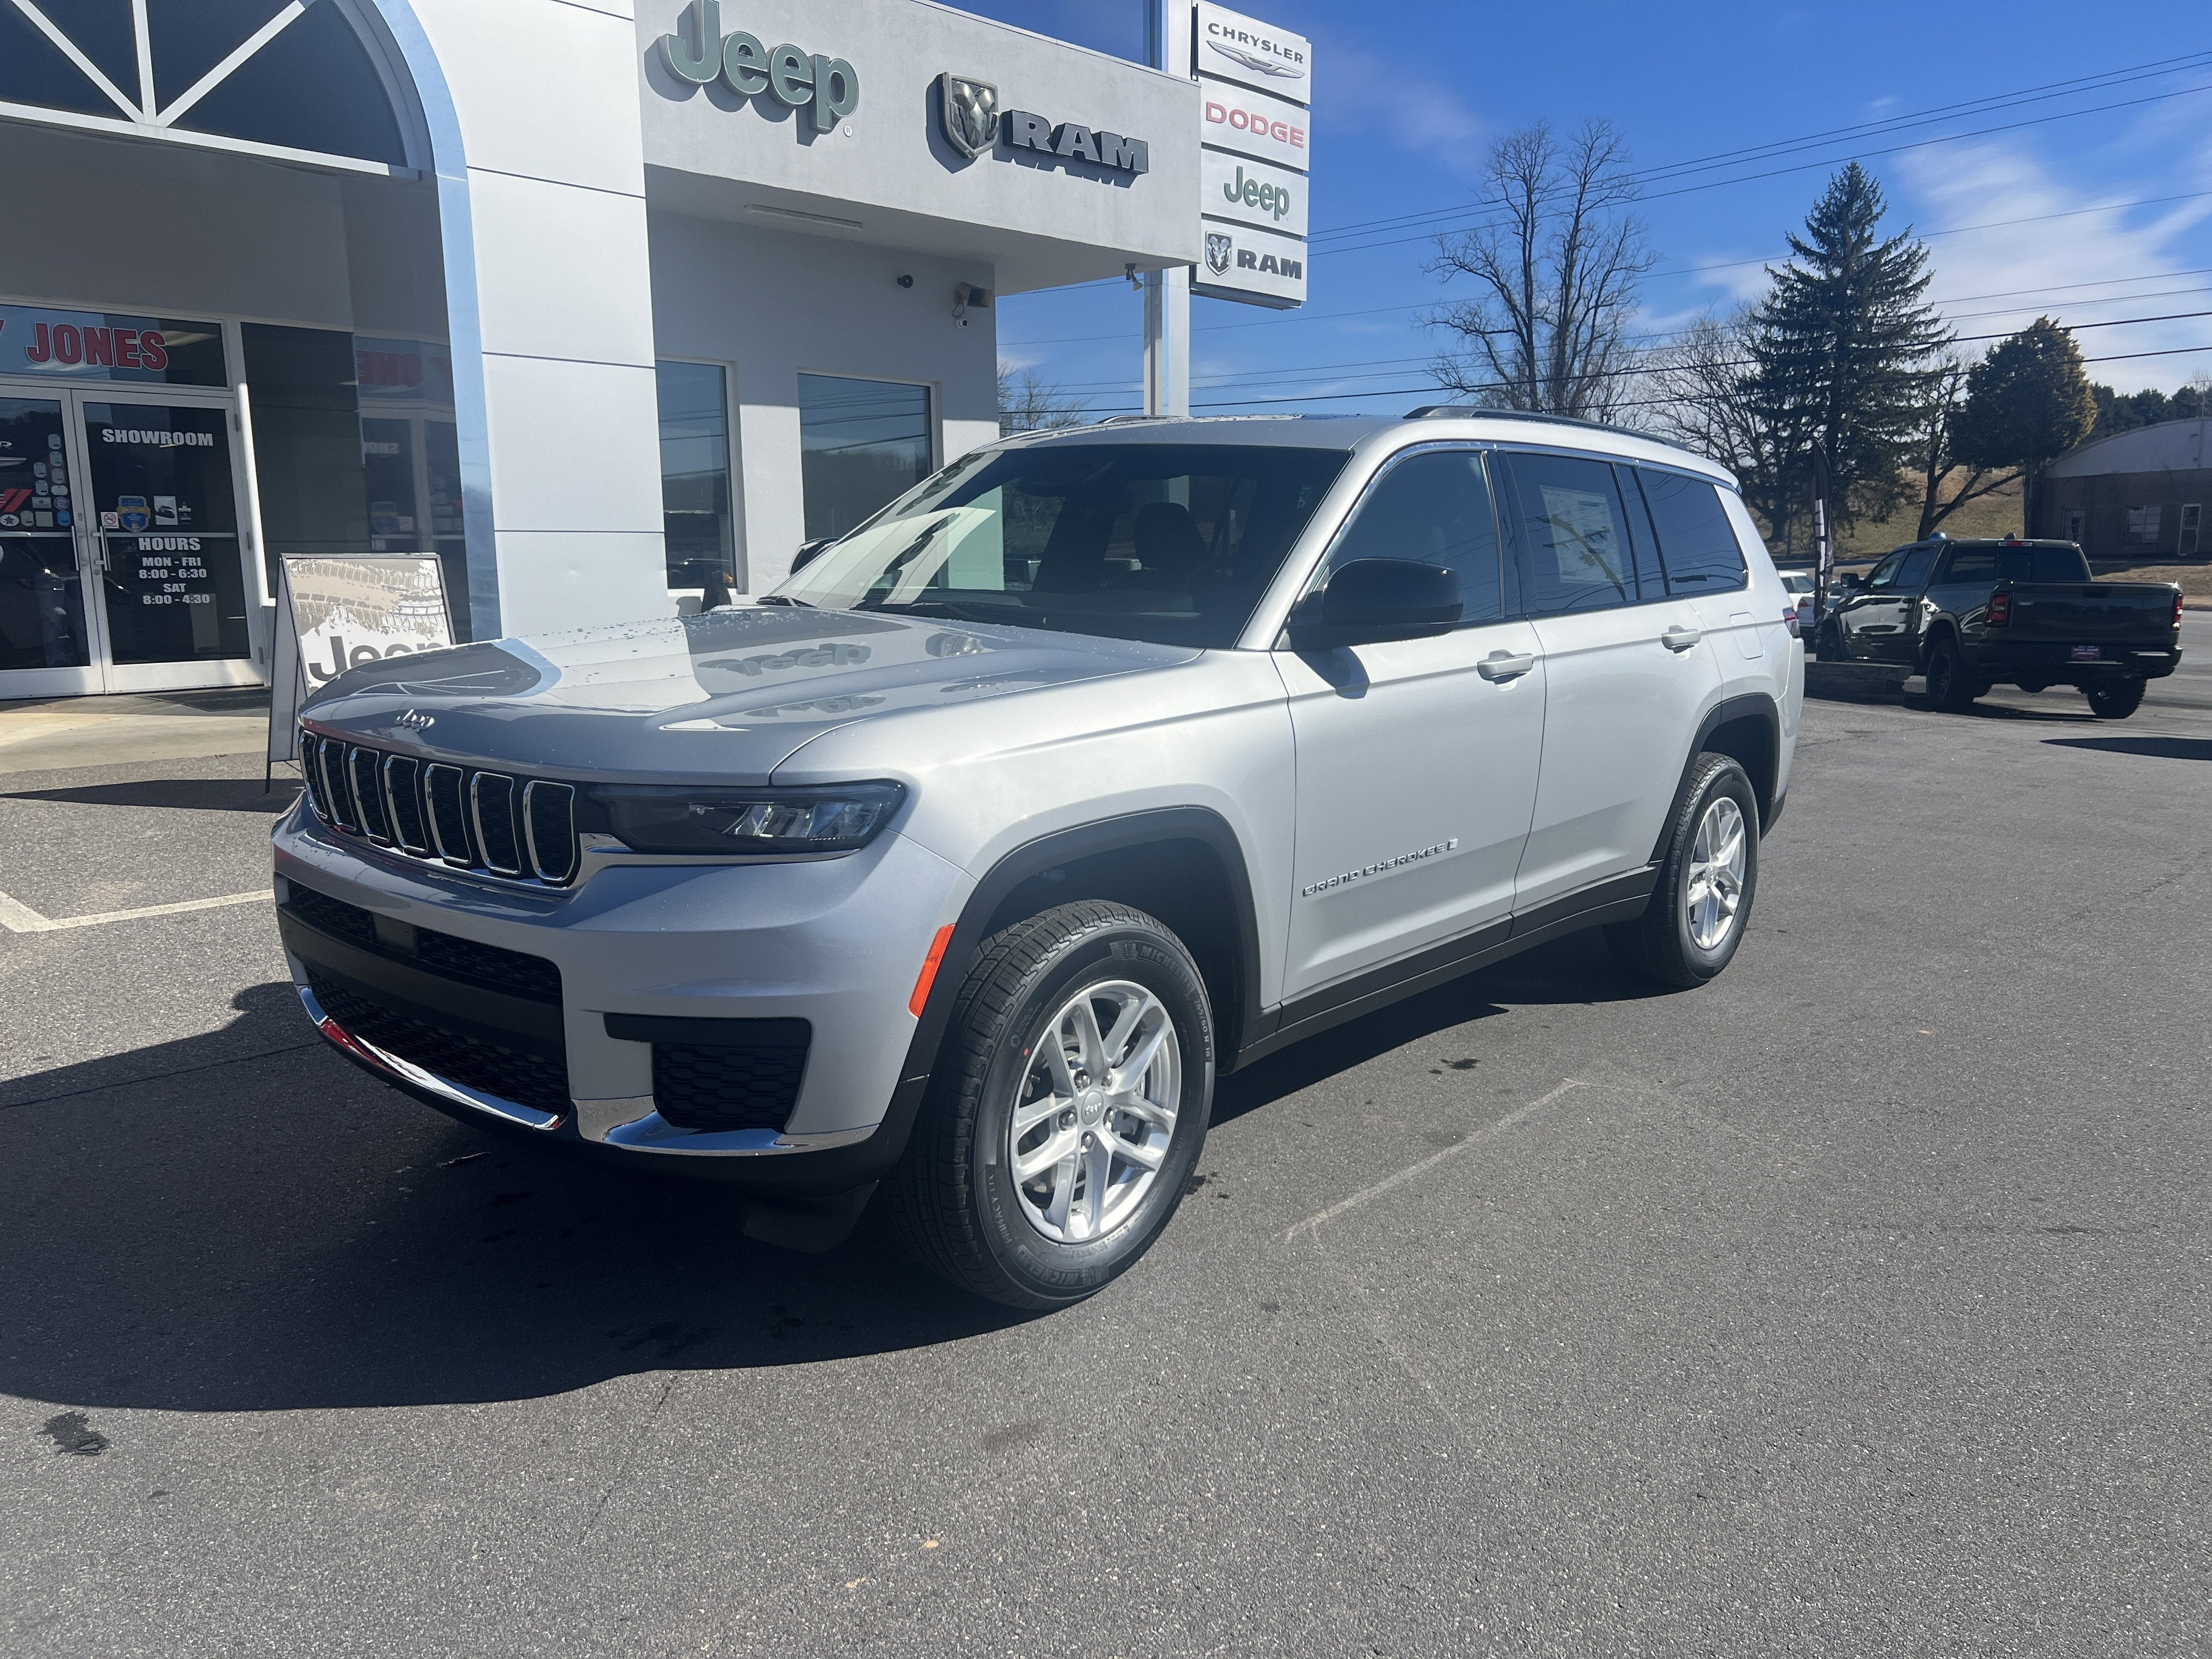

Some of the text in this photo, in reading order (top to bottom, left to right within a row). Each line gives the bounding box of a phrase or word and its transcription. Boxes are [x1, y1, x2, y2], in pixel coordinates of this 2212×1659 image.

[1207, 22, 1304, 64] CHRYSLER
[665, 0, 859, 131] Jeep
[1009, 109, 1149, 173] RAM
[1206, 101, 1305, 149] DODGE
[1223, 165, 1290, 221] Jeep
[1237, 249, 1302, 280] RAM
[26, 321, 168, 371] JONES
[101, 428, 213, 447] SHOWROOM
[138, 537, 201, 551] HOURS
[138, 569, 168, 579] 8:00
[178, 568, 207, 578] 6:30
[142, 557, 172, 567] MON
[182, 557, 201, 566] FRI
[143, 595, 172, 605] 8:00
[182, 594, 210, 603] 4:30
[163, 583, 187, 592] SAT
[394, 708, 435, 733] Jeep
[1302, 870, 1360, 897] GRAND
[1363, 843, 1445, 877] CHEROKEE
[1194, 999, 1208, 1032] 265/60
[991, 1196, 1013, 1244] PRIMACY
